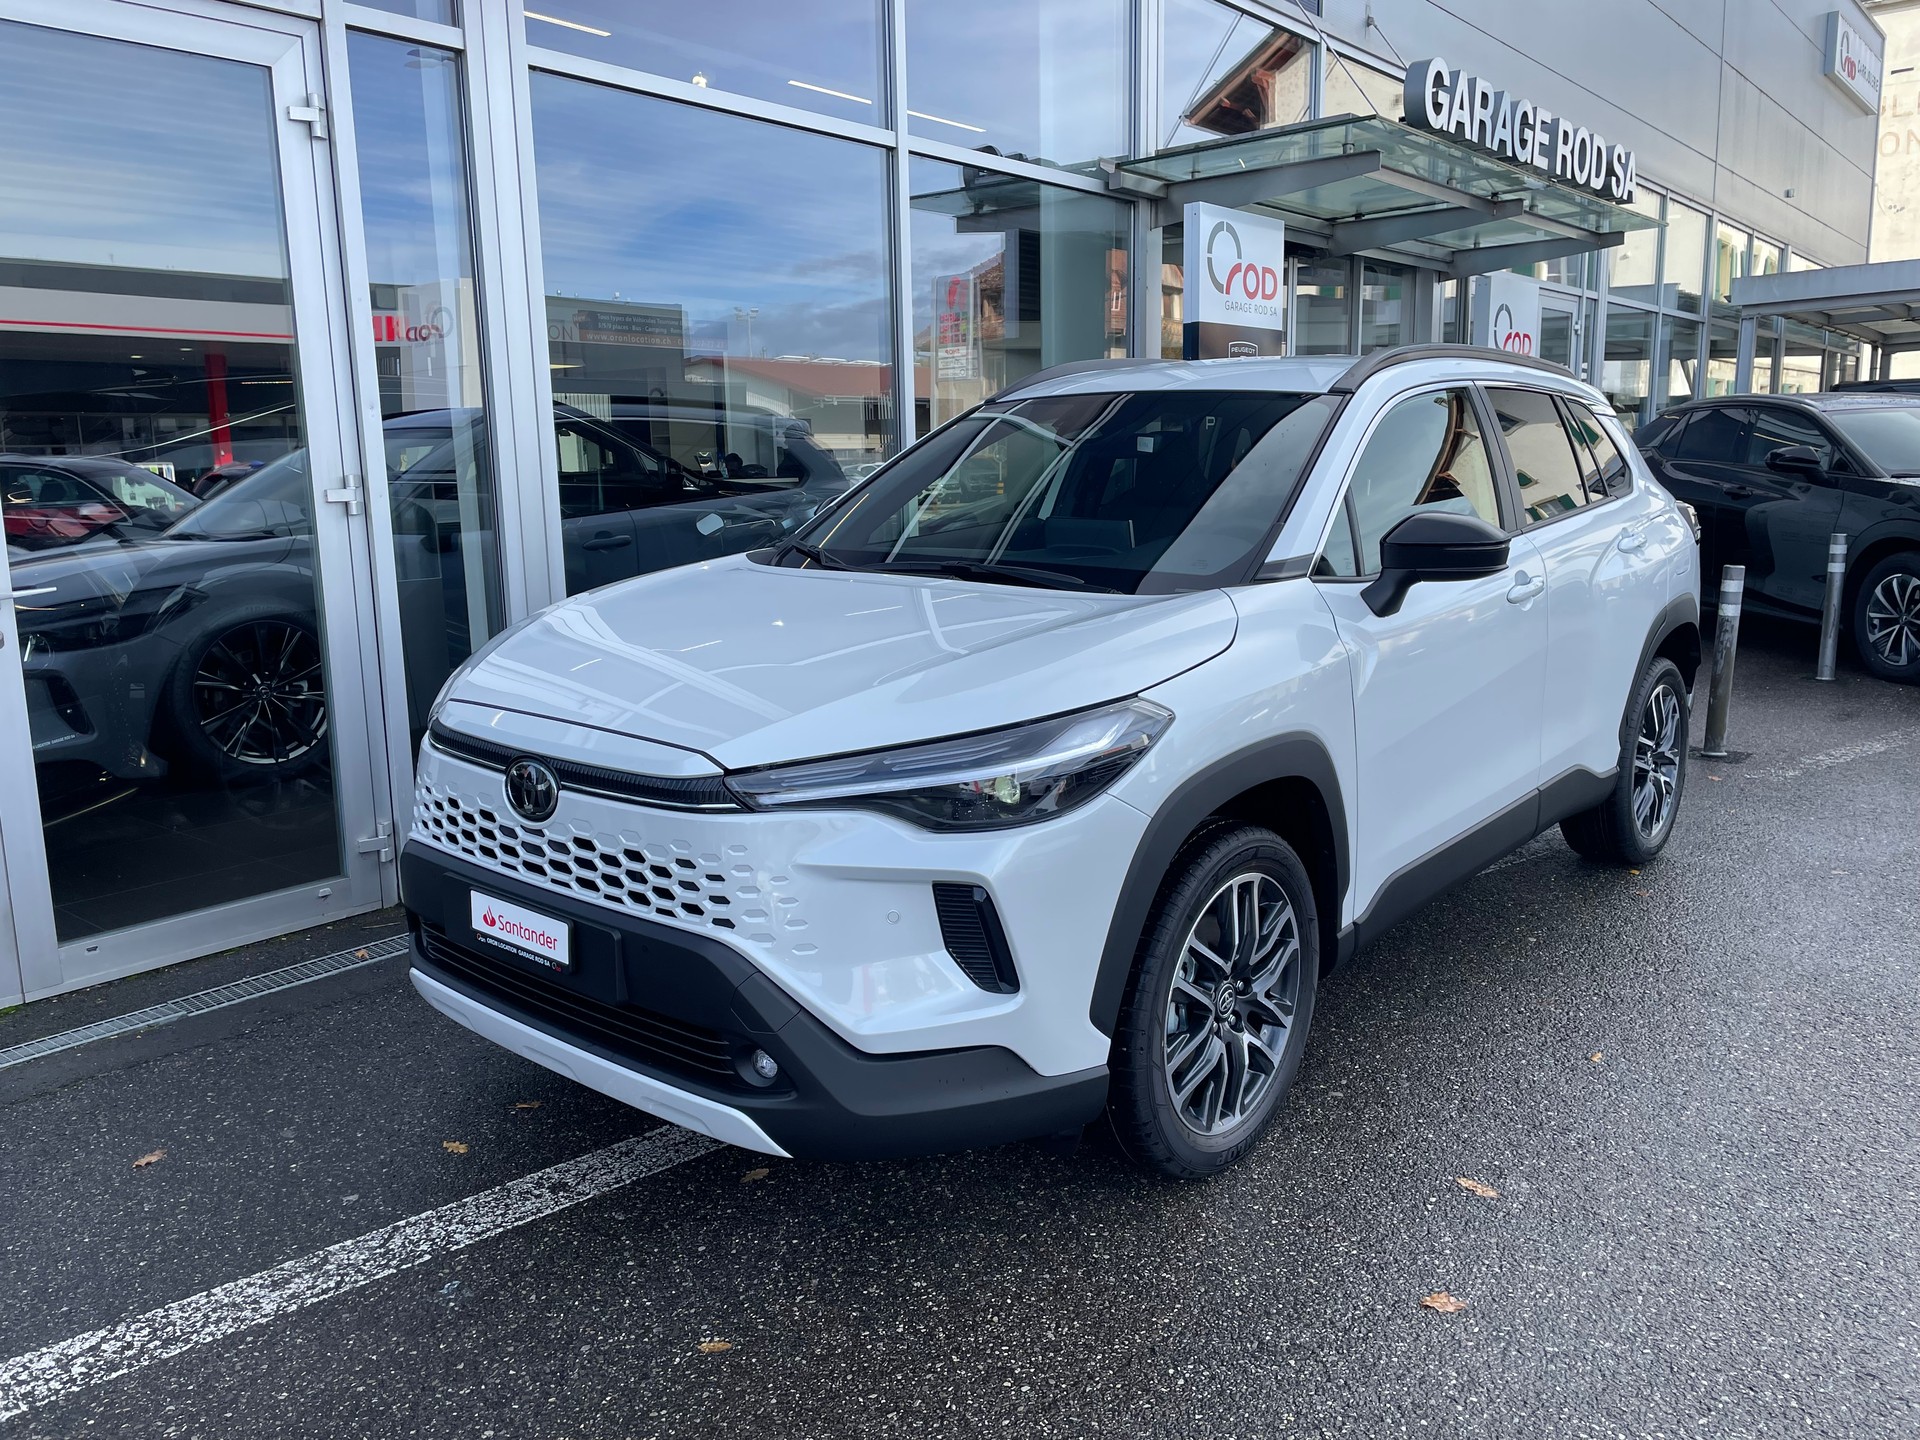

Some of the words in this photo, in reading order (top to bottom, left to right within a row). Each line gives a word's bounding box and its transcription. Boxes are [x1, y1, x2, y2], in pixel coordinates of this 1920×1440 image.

[1424, 56, 1551, 170] GARAGE
[1555, 117, 1607, 190] ROD
[1611, 143, 1637, 201] SA
[1224, 300, 1252, 314] GARAGE
[1254, 304, 1268, 316] ROD
[1269, 306, 1278, 317] SA
[1231, 346, 1255, 354] PEUGEOT
[498, 915, 557, 950] Santander
[518, 949, 535, 961] GARAGE
